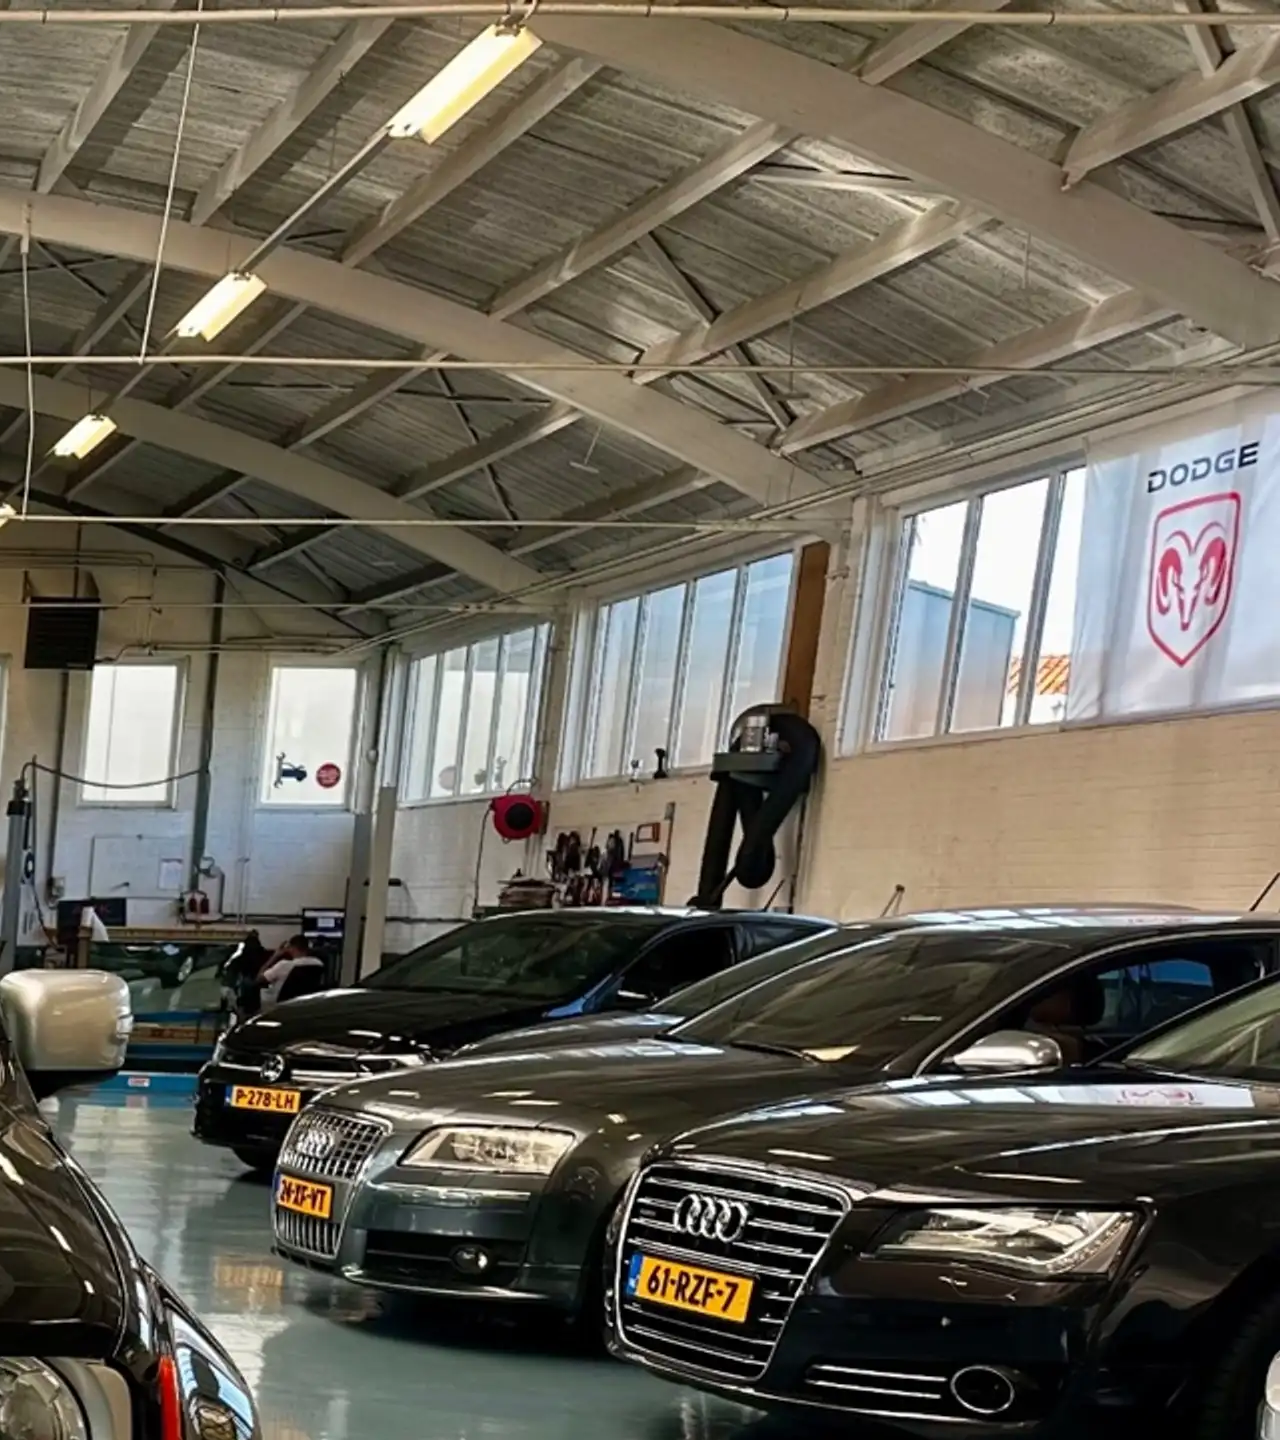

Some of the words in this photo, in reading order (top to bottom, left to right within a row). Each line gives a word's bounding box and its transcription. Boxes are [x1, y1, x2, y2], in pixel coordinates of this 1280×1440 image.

[1147, 441, 1260, 494] DODGE
[235, 1087, 295, 1110] P-278-LH
[647, 1265, 739, 1314] 61-RZF-7
